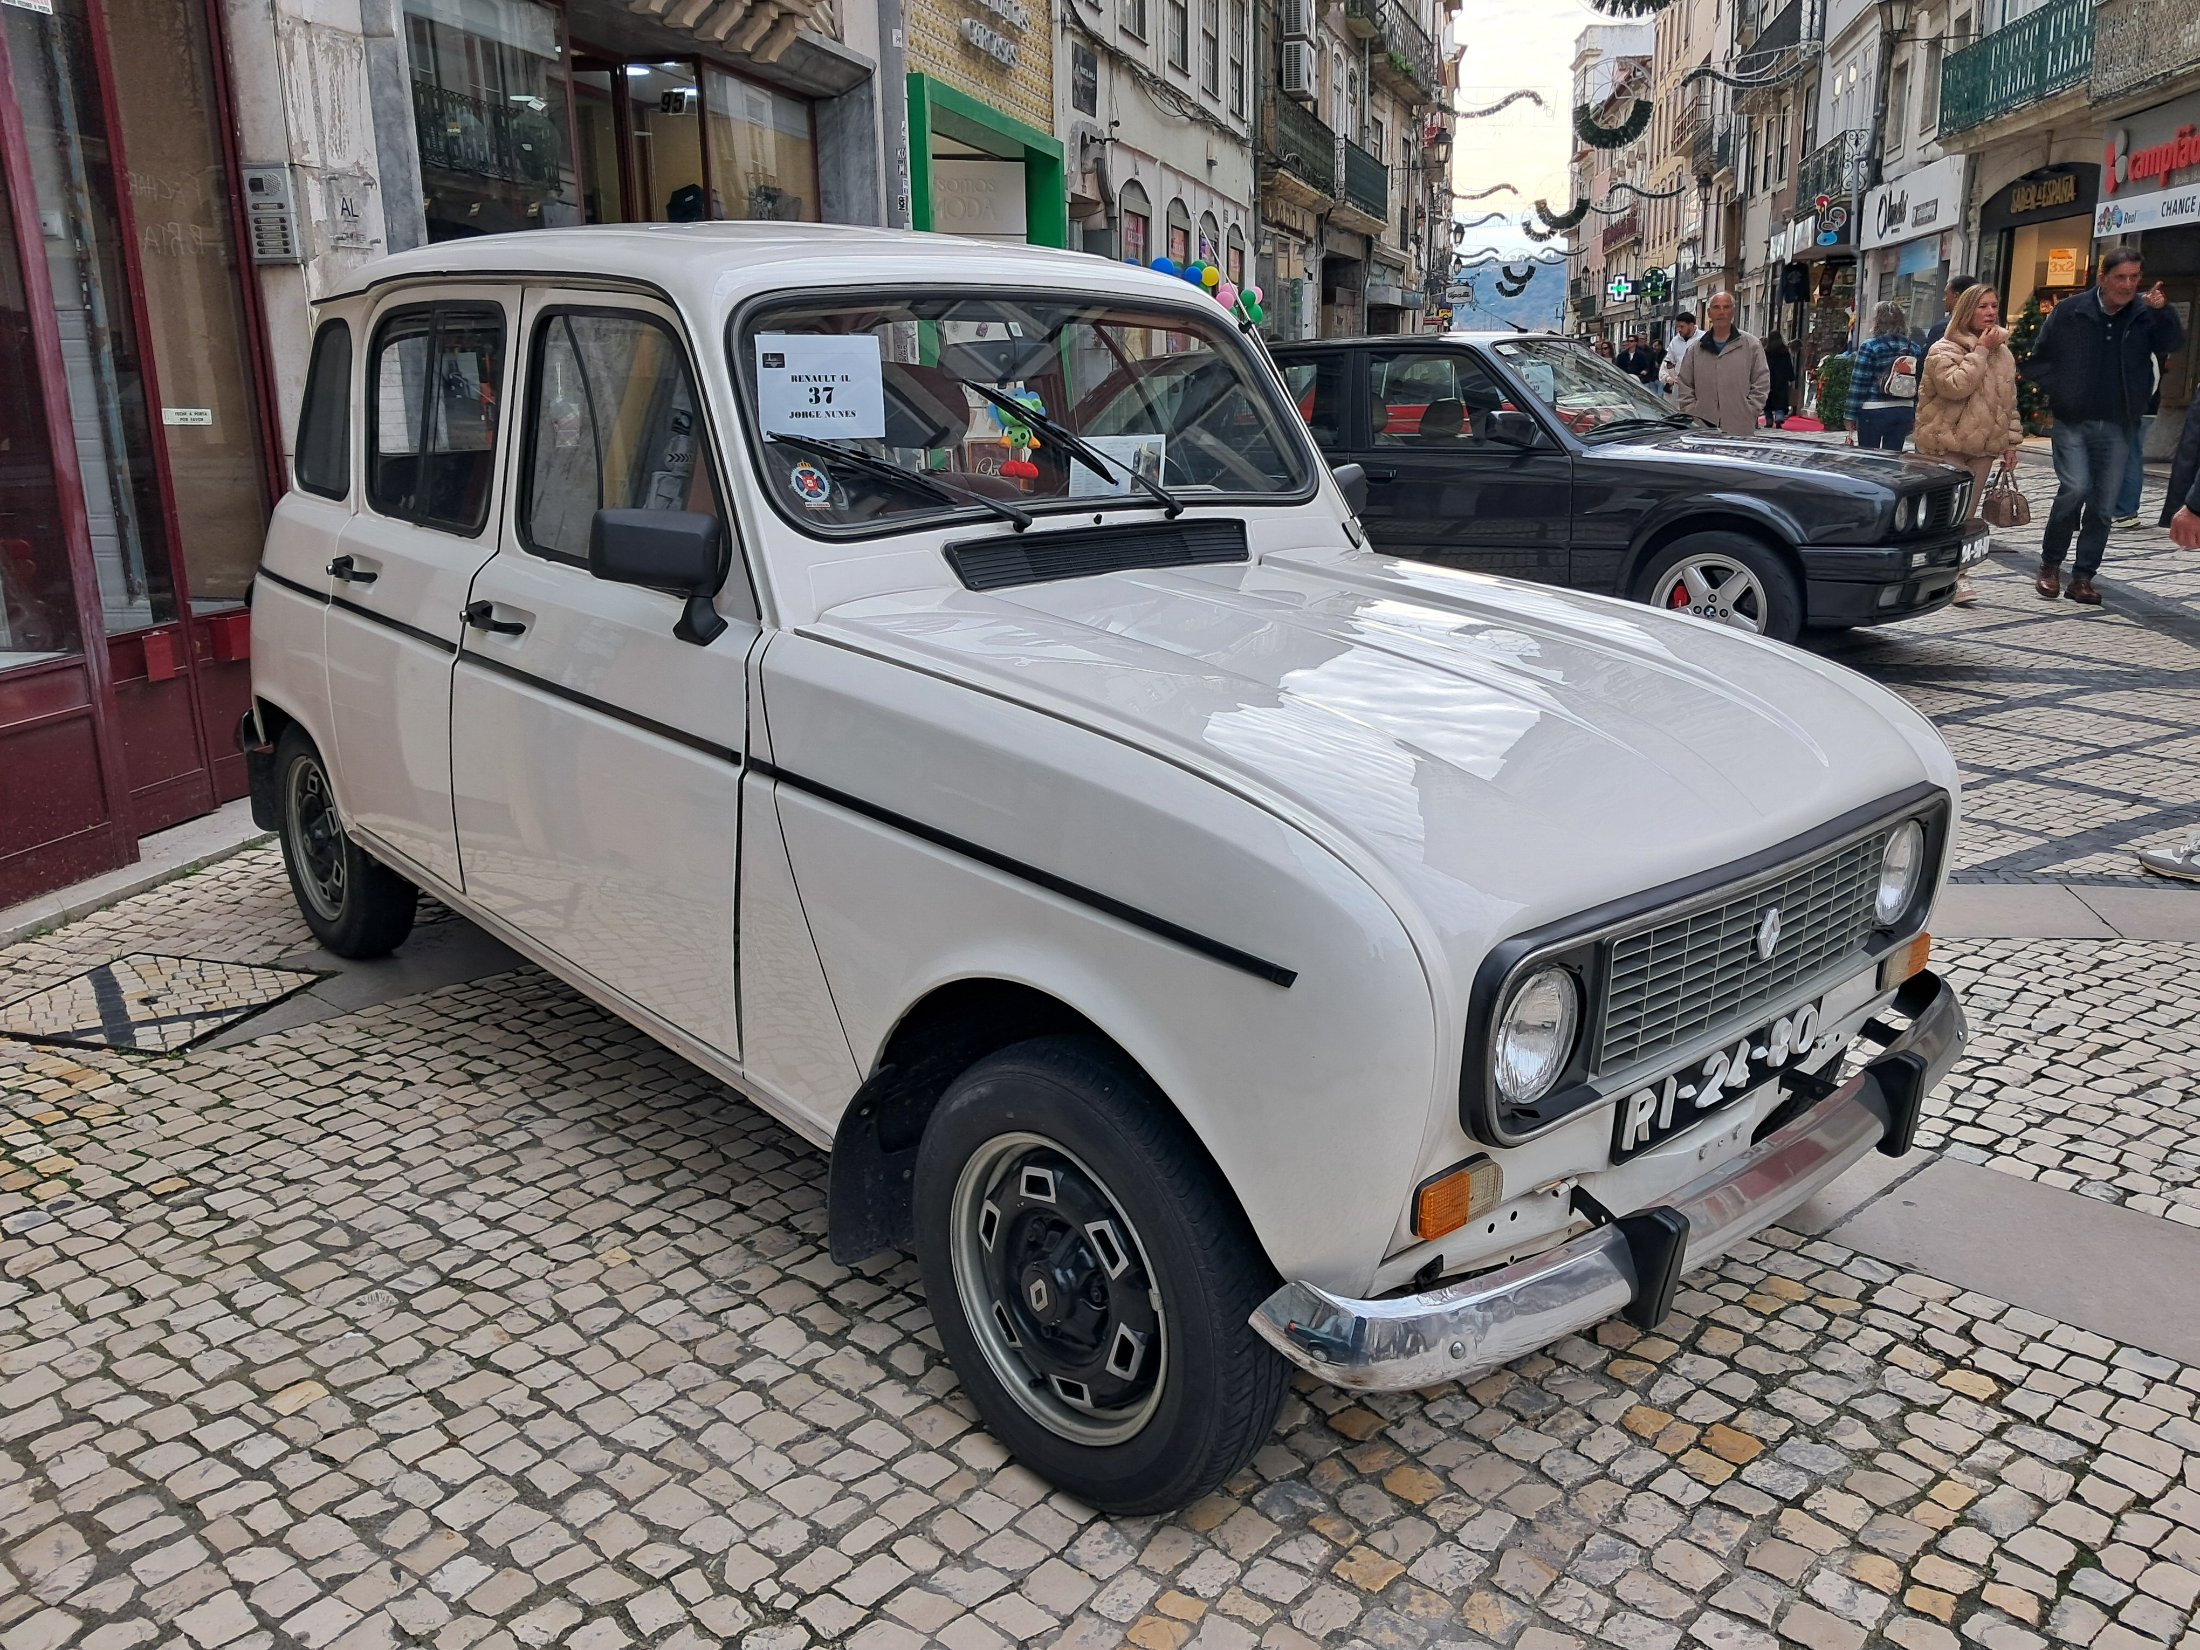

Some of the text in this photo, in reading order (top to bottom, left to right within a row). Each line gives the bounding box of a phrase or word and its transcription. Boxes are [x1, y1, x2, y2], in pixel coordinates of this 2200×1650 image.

[661, 91, 684, 113] 95
[936, 177, 996, 193] somos
[340, 197, 360, 218] AL
[2161, 196, 2197, 218] CHANGE
[2049, 261, 2075, 273] 3x2
[790, 374, 837, 383] RENAULT
[808, 386, 835, 405] 37
[788, 409, 857, 419] JORGE NUNES
